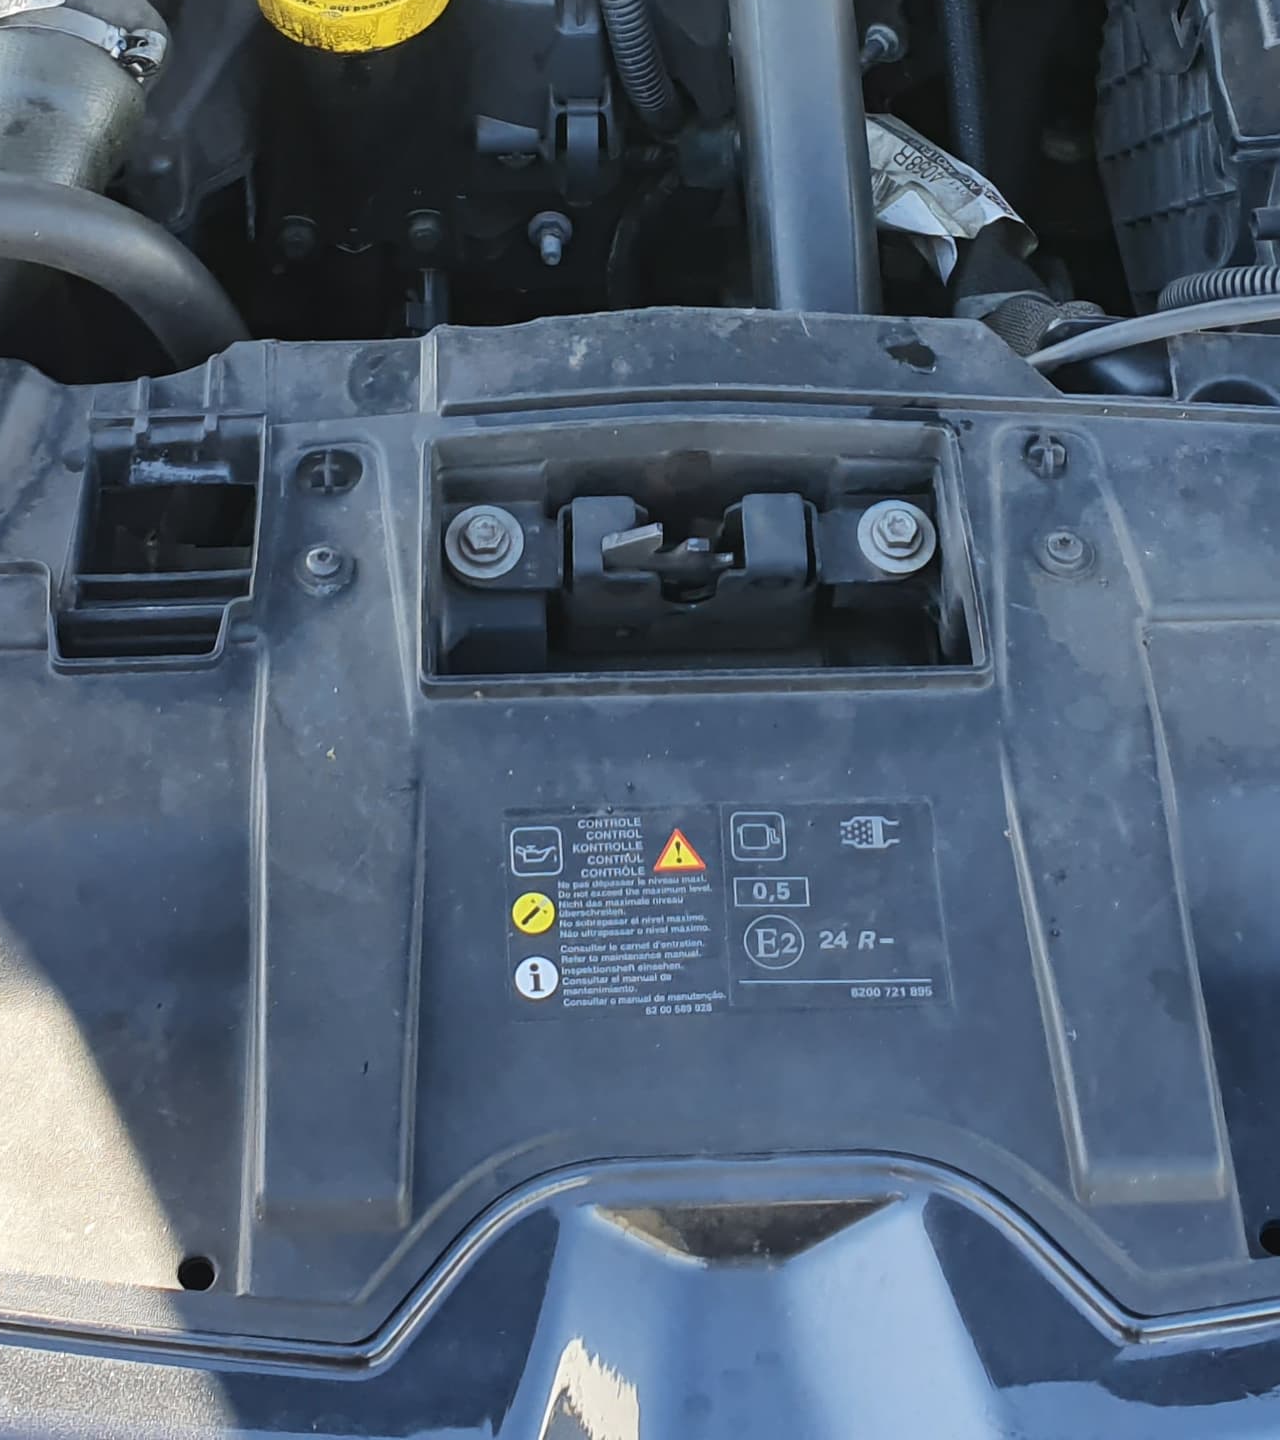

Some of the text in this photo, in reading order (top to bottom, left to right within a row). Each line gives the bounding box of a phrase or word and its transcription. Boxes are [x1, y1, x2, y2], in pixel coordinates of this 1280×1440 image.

[577, 817, 641, 829] CONTROLE
[586, 829, 643, 840] CONTROL
[572, 841, 643, 853] KONTROLLE
[581, 865, 645, 878] CONTRÔLE
[573, 881, 589, 889] pas
[648, 877, 679, 886] niveau
[558, 885, 712, 898] Do not exceed the maximum level.
[753, 882, 791, 903] 0,5
[559, 900, 583, 909] Nicht
[605, 897, 650, 907] maximale
[560, 919, 572, 928] No
[642, 915, 664, 924] nivel
[581, 928, 634, 938] ultrapassar
[560, 944, 606, 953] Consulter
[620, 942, 649, 951] carnet
[755, 928, 798, 958] E2
[819, 931, 849, 949] 24
[561, 955, 585, 963] Refer
[601, 953, 661, 962] maintenance
[665, 950, 701, 958] manual.
[562, 964, 635, 975] Inspektionsheft
[562, 973, 672, 985] Consultar el manual de
[885, 986, 906, 997] 721
[563, 998, 608, 1007] Consultar
[618, 995, 652, 1004] manual
[654, 994, 665, 1002] de
[660, 1005, 672, 1014] 00
